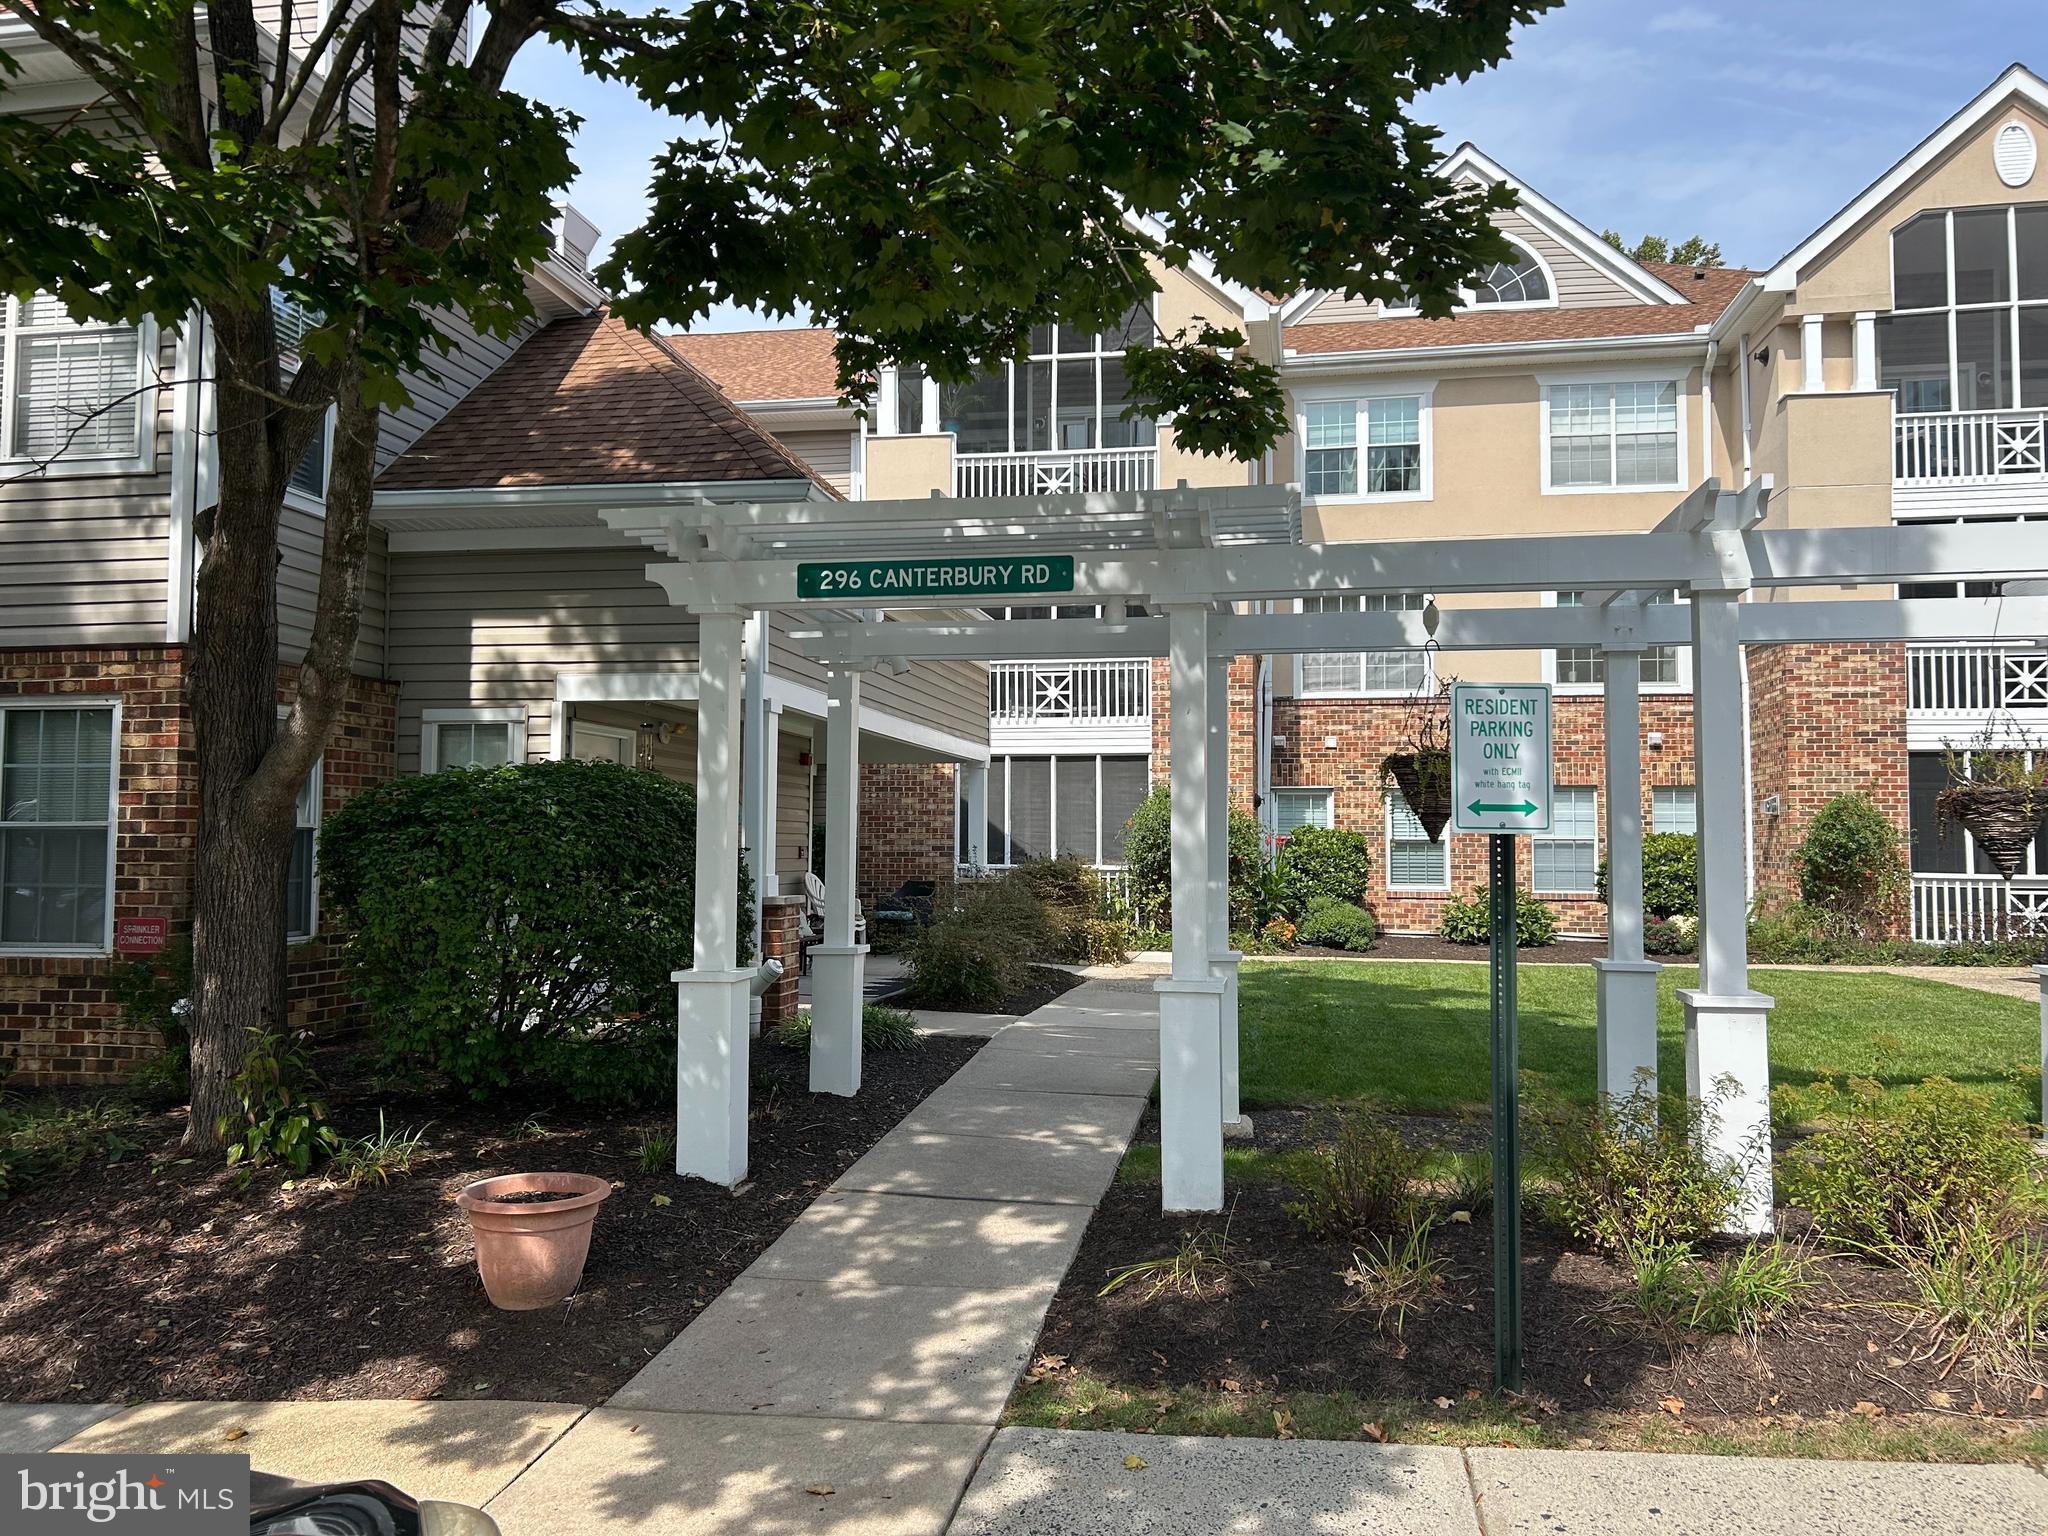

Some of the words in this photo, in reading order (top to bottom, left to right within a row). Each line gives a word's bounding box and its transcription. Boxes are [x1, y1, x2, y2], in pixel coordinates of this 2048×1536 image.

[819, 569, 862, 590] 296
[869, 565, 1014, 588] CANTERBURY
[1021, 564, 1050, 585] RD
[1465, 699, 1538, 716] RESIDENT
[1470, 721, 1533, 737] PARKING
[1483, 743, 1520, 759] ONLY
[1483, 767, 1499, 776] with
[1475, 780, 1495, 788] white
[1497, 780, 1515, 791] hang
[1518, 781, 1531, 791] tag
[123, 925, 160, 934] SPRINKLER
[120, 936, 164, 945] CONNECTION
